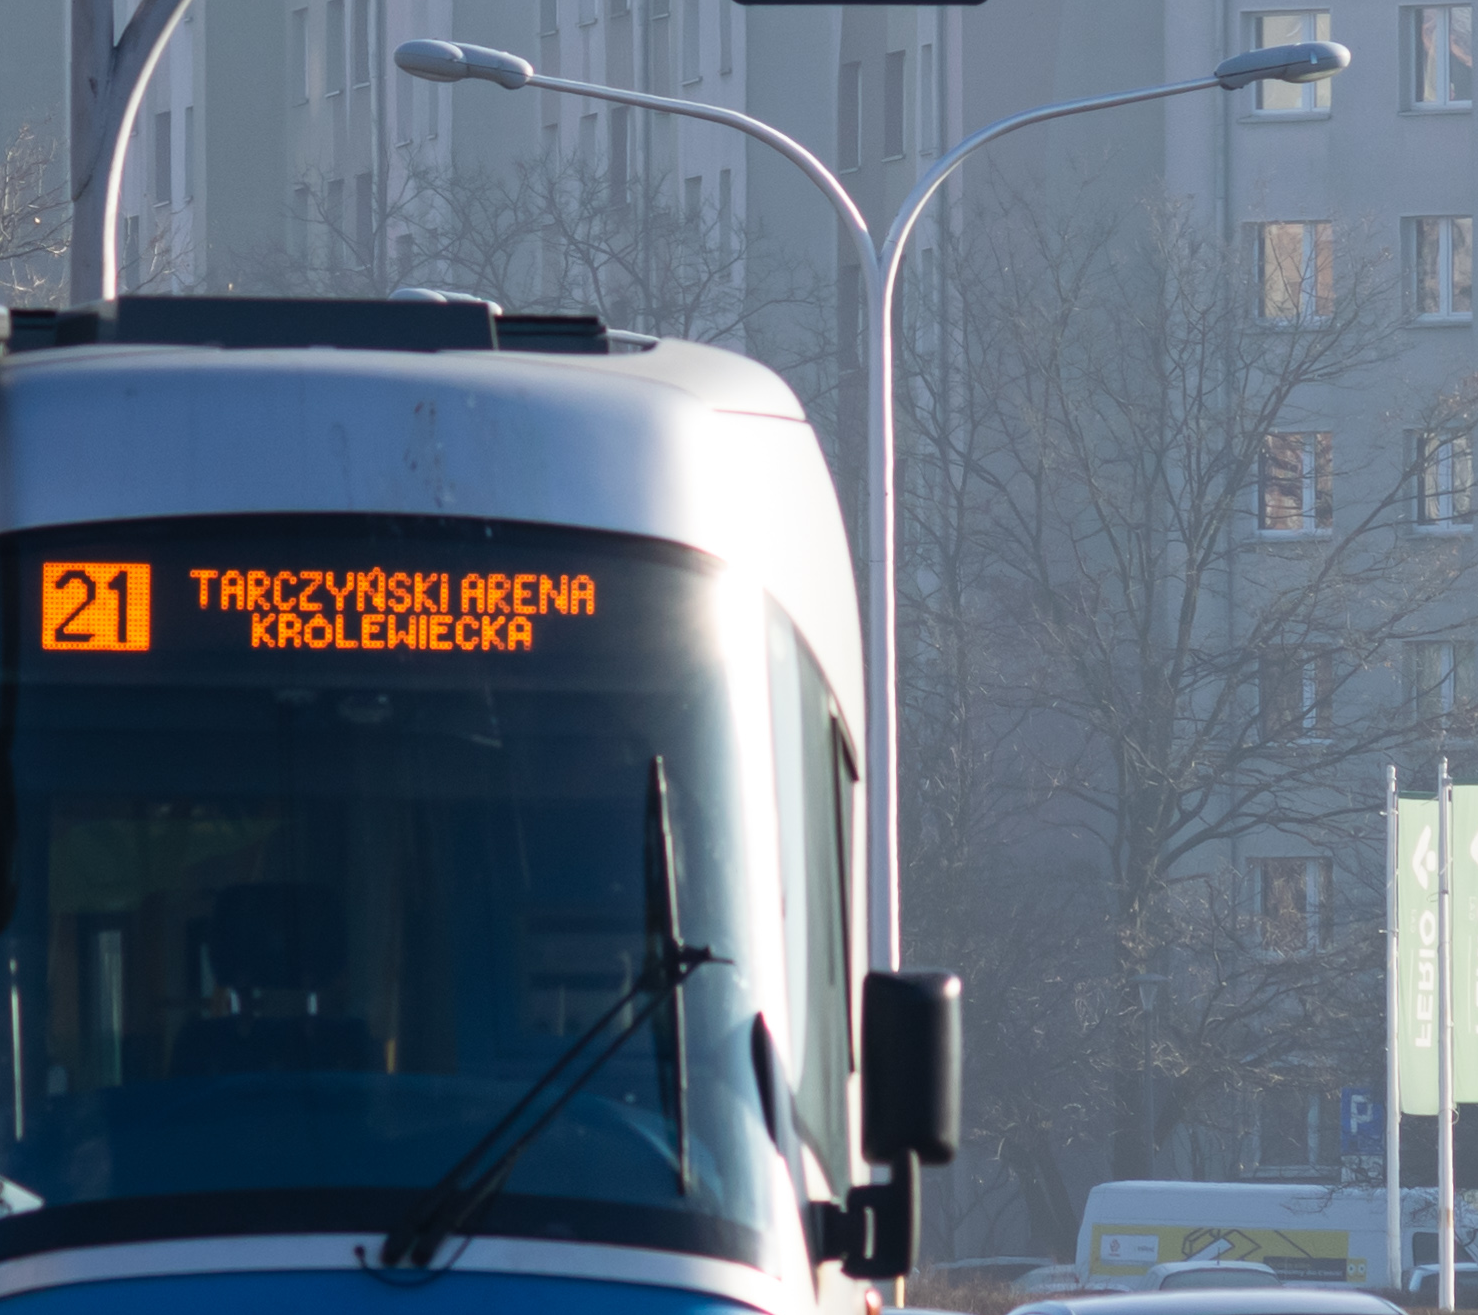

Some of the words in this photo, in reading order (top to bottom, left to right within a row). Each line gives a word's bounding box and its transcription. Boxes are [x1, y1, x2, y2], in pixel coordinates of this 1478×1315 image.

[52, 569, 132, 644] 21
[189, 567, 450, 614] TARCZYŃSKI
[460, 573, 596, 615] ARENA
[250, 612, 534, 652] KRÓLEWIECKA
